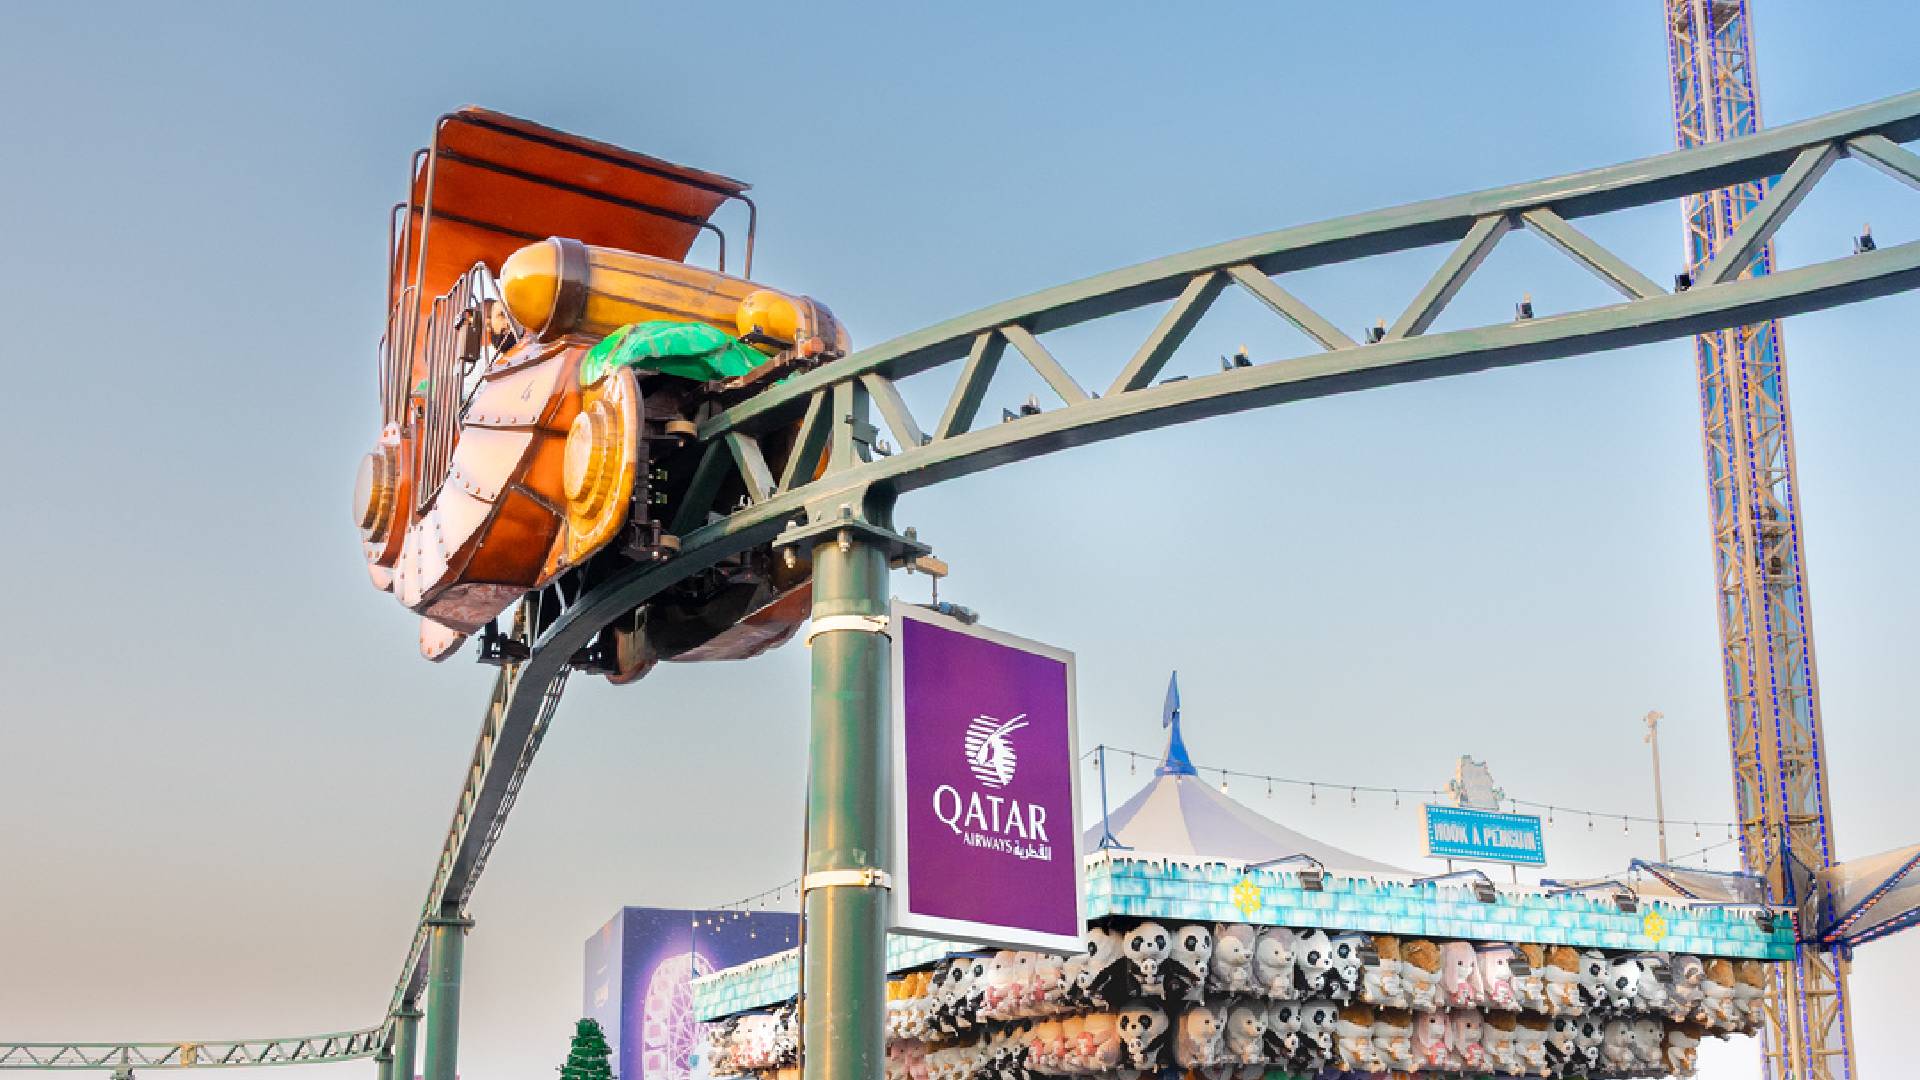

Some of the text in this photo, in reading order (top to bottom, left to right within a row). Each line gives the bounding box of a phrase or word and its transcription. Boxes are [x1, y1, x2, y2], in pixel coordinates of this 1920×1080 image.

[933, 785, 1049, 842] QATAR
[964, 831, 1012, 854] AIRWAYS
[1434, 822, 1537, 851] HOOK A PENGUIN
